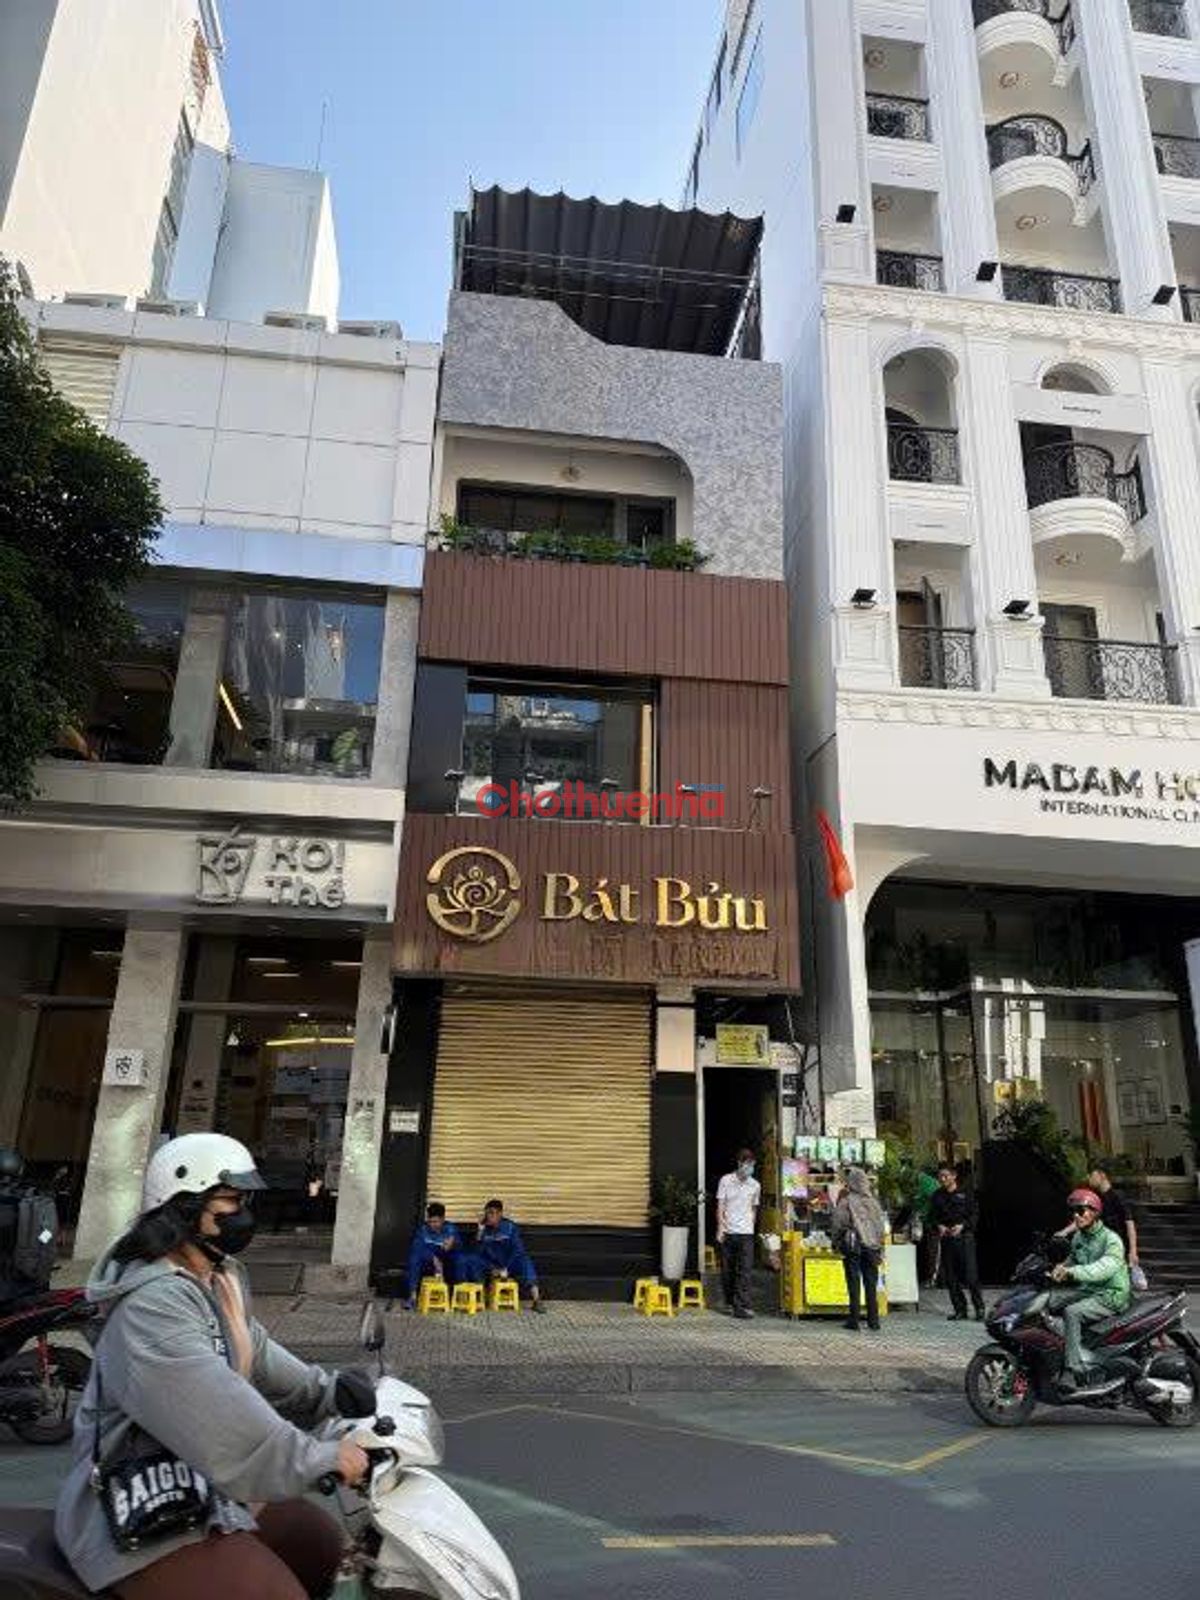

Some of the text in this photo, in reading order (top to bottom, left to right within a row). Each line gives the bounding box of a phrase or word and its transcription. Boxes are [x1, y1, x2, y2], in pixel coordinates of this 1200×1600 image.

[985, 757, 1143, 799] MADAM
[1040, 799, 1170, 821] INTERNATIONAL
[540, 873, 770, 931] Bát Bửu
